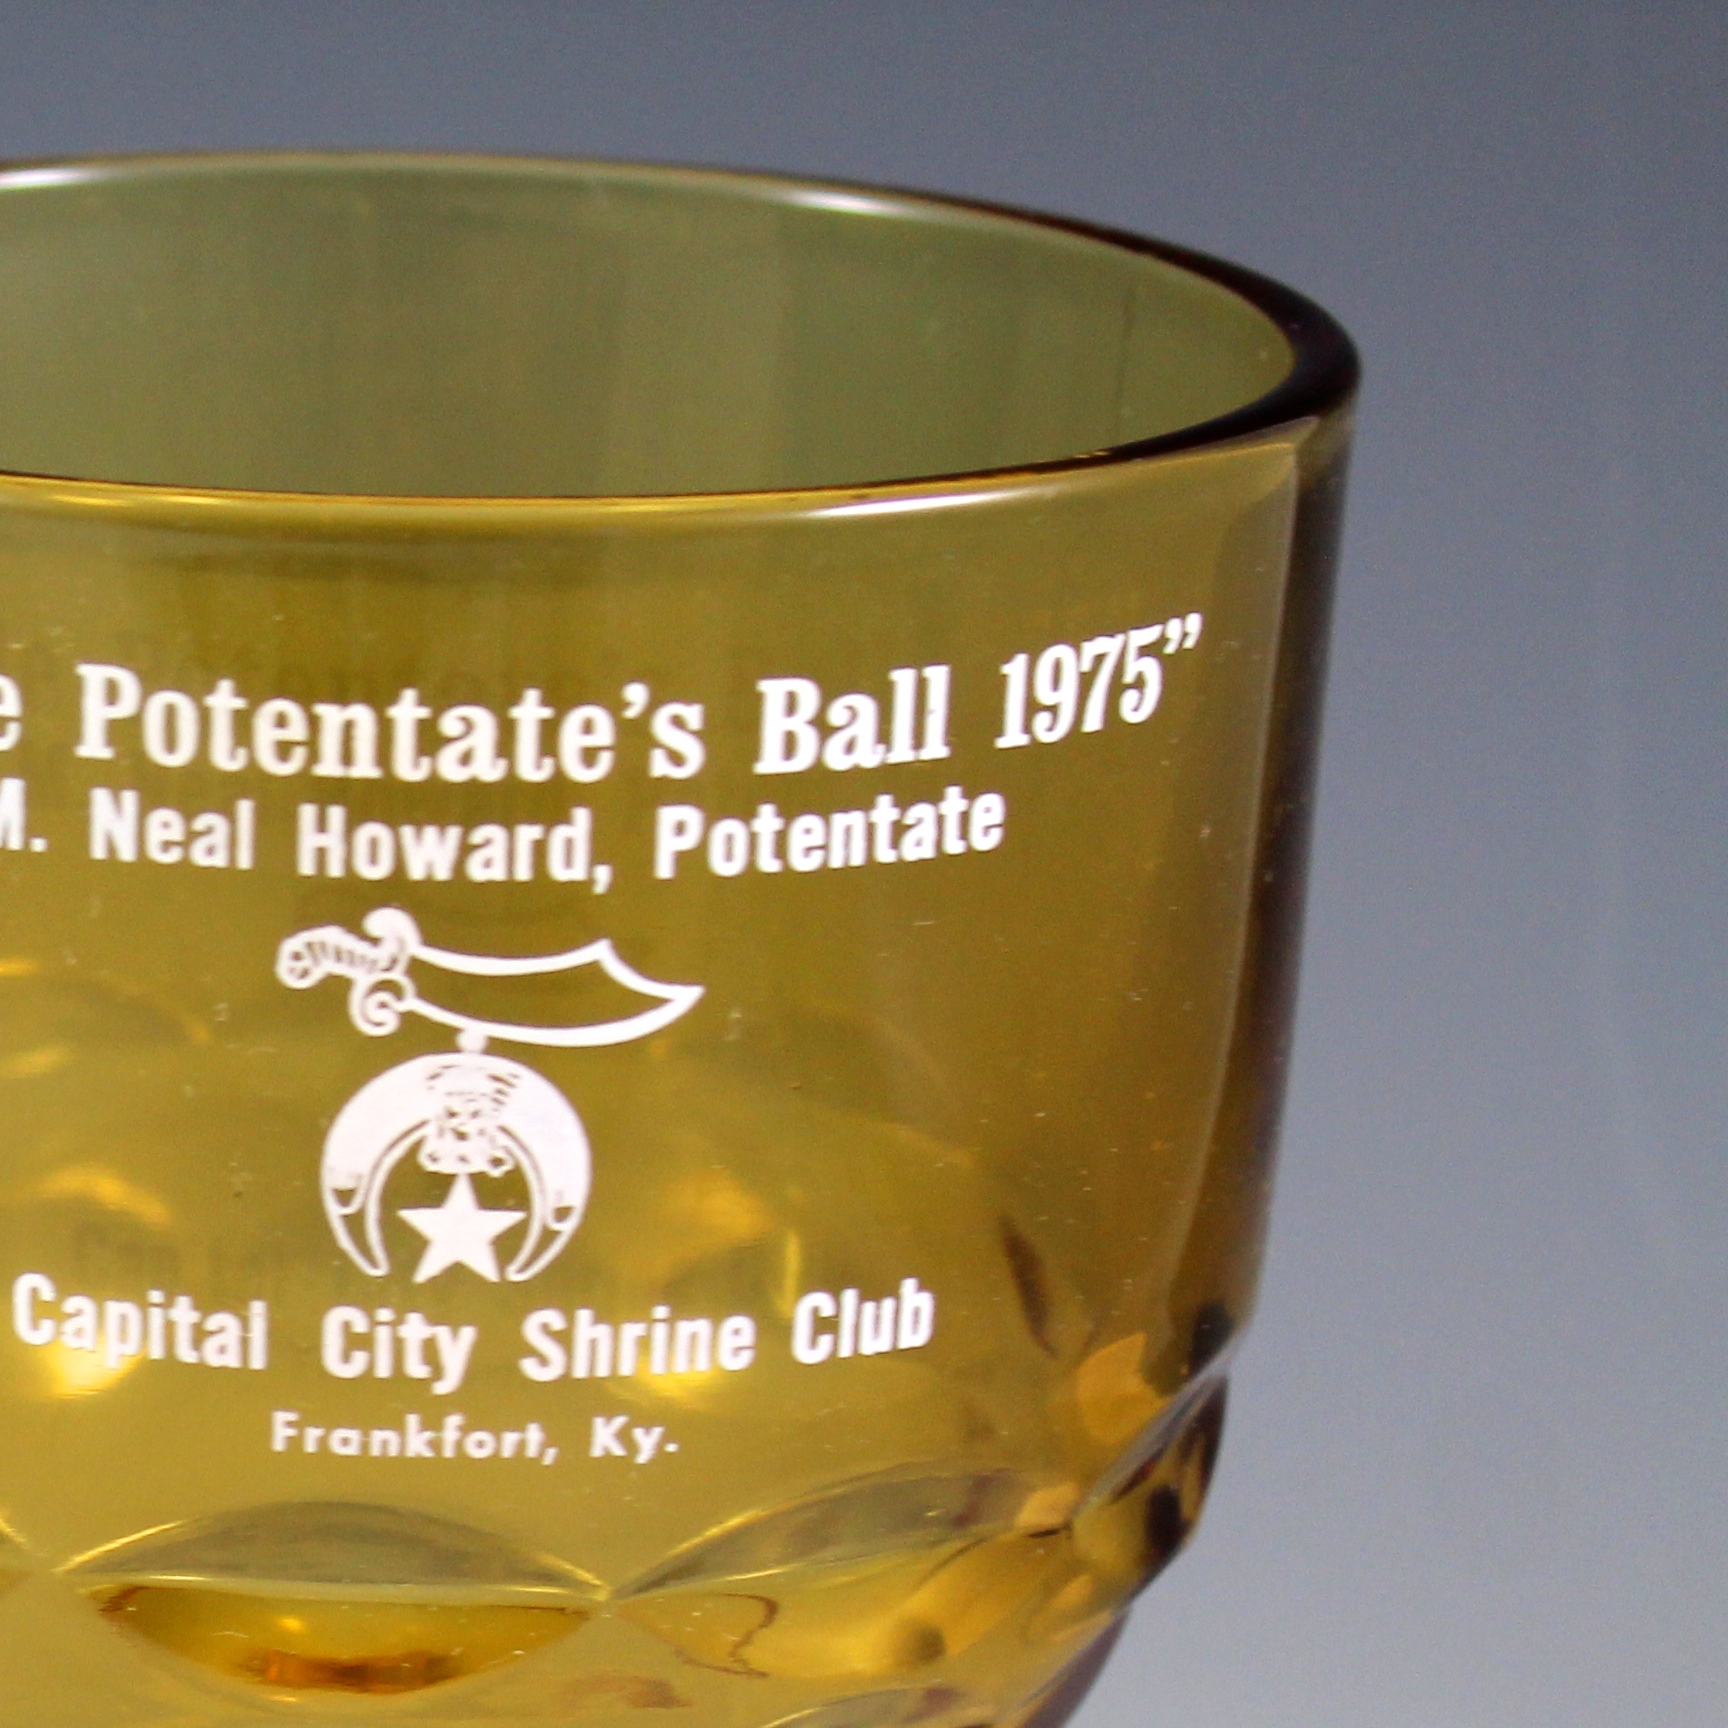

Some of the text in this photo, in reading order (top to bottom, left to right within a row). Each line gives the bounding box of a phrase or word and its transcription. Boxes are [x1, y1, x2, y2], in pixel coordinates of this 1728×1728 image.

[754, 664, 950, 774] Ball
[90, 788, 254, 869] Neal
[655, 786, 1006, 882] Potentate
[13, 1273, 935, 1395] Capital City Shrine Club
[590, 1415, 679, 1464] Ky.
